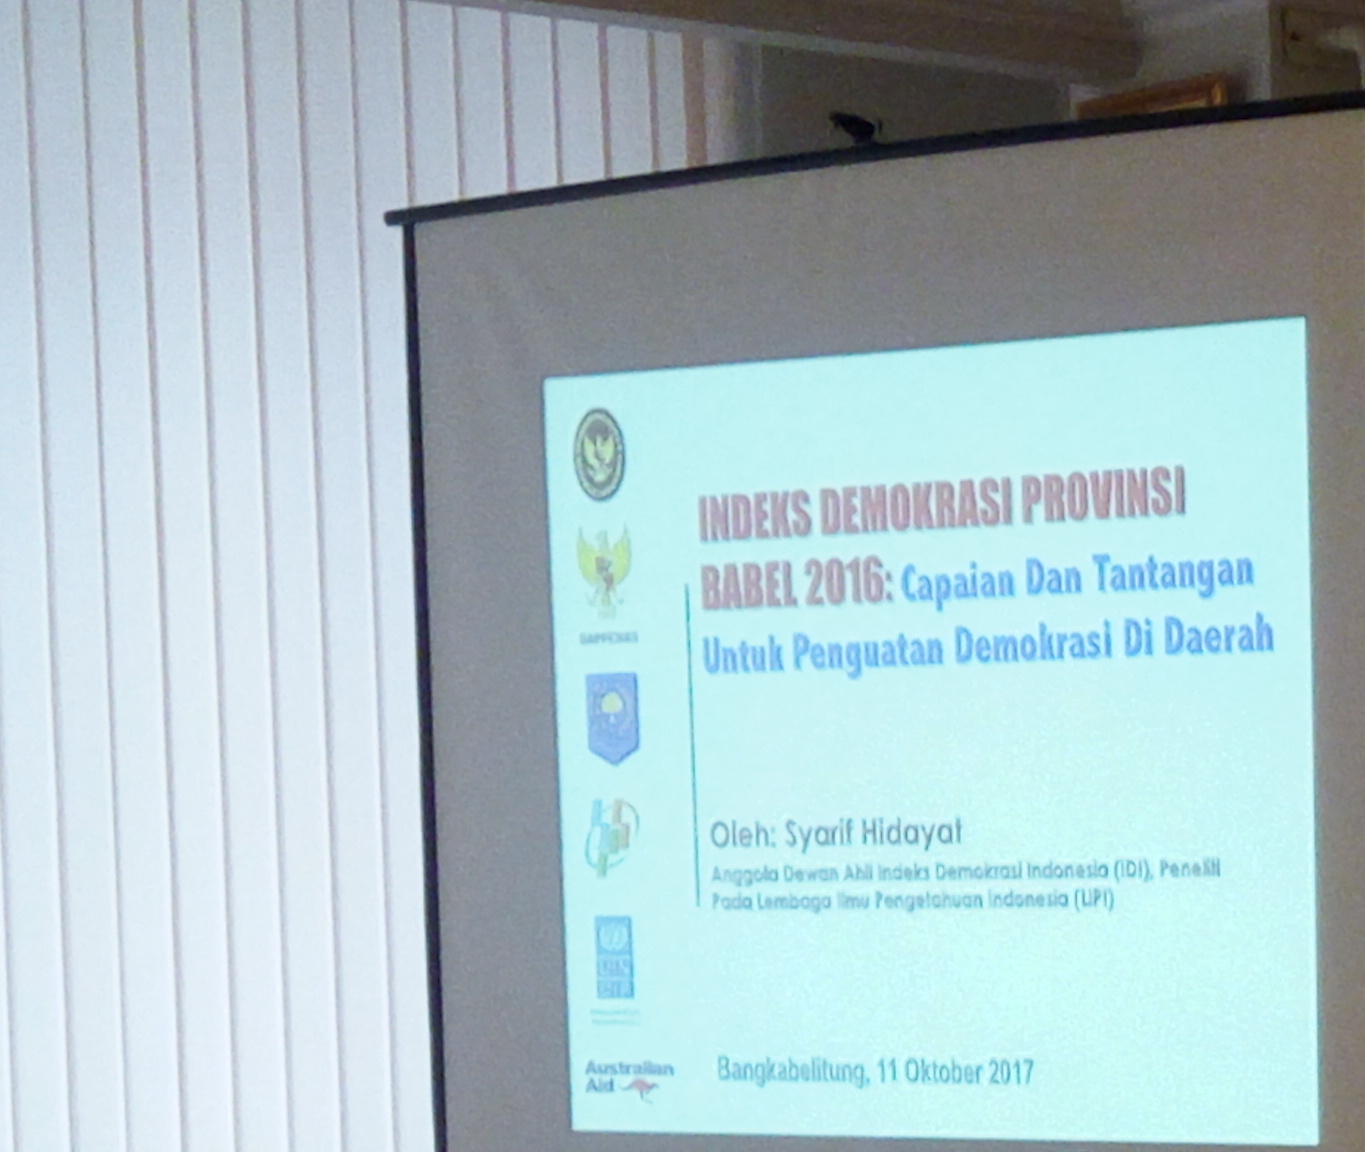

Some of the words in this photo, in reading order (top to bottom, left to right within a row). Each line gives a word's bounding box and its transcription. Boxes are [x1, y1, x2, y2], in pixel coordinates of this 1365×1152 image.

[698, 490, 813, 543] INDEKS
[819, 476, 1013, 537] DEMOKRASI
[1021, 465, 1187, 525] PROVINSI
[701, 560, 799, 611] BABEL
[804, 554, 895, 606] 2016:
[901, 561, 1015, 612] Capaian
[1025, 556, 1082, 596] Dan
[1091, 553, 1255, 599] Tantangan
[702, 634, 785, 675] Untuk
[792, 632, 944, 680] Penguatan
[954, 618, 1113, 664] Demokrasi
[1123, 617, 1154, 657] Di
[1163, 611, 1275, 656] Daerah
[710, 819, 778, 849] Oleh:
[785, 817, 853, 854] Syarif
[861, 816, 963, 852] Hidayat
[711, 865, 779, 887] Anggota
[782, 863, 839, 882] Dewan
[843, 863, 874, 882] Ahli
[877, 862, 931, 882] Indeks
[935, 860, 1023, 880] Demokrasi
[1026, 859, 1110, 880] Indonesia
[711, 892, 753, 911] Pada
[757, 891, 832, 914] Lembaga
[875, 890, 984, 913] Pengetahuan
[988, 888, 1070, 909] Indonesia
[585, 1059, 675, 1077] Australian
[877, 1058, 898, 1082] 11
[905, 1058, 984, 1085] Oktober
[988, 1058, 1036, 1086] 2017
[586, 1077, 615, 1094] Aid
